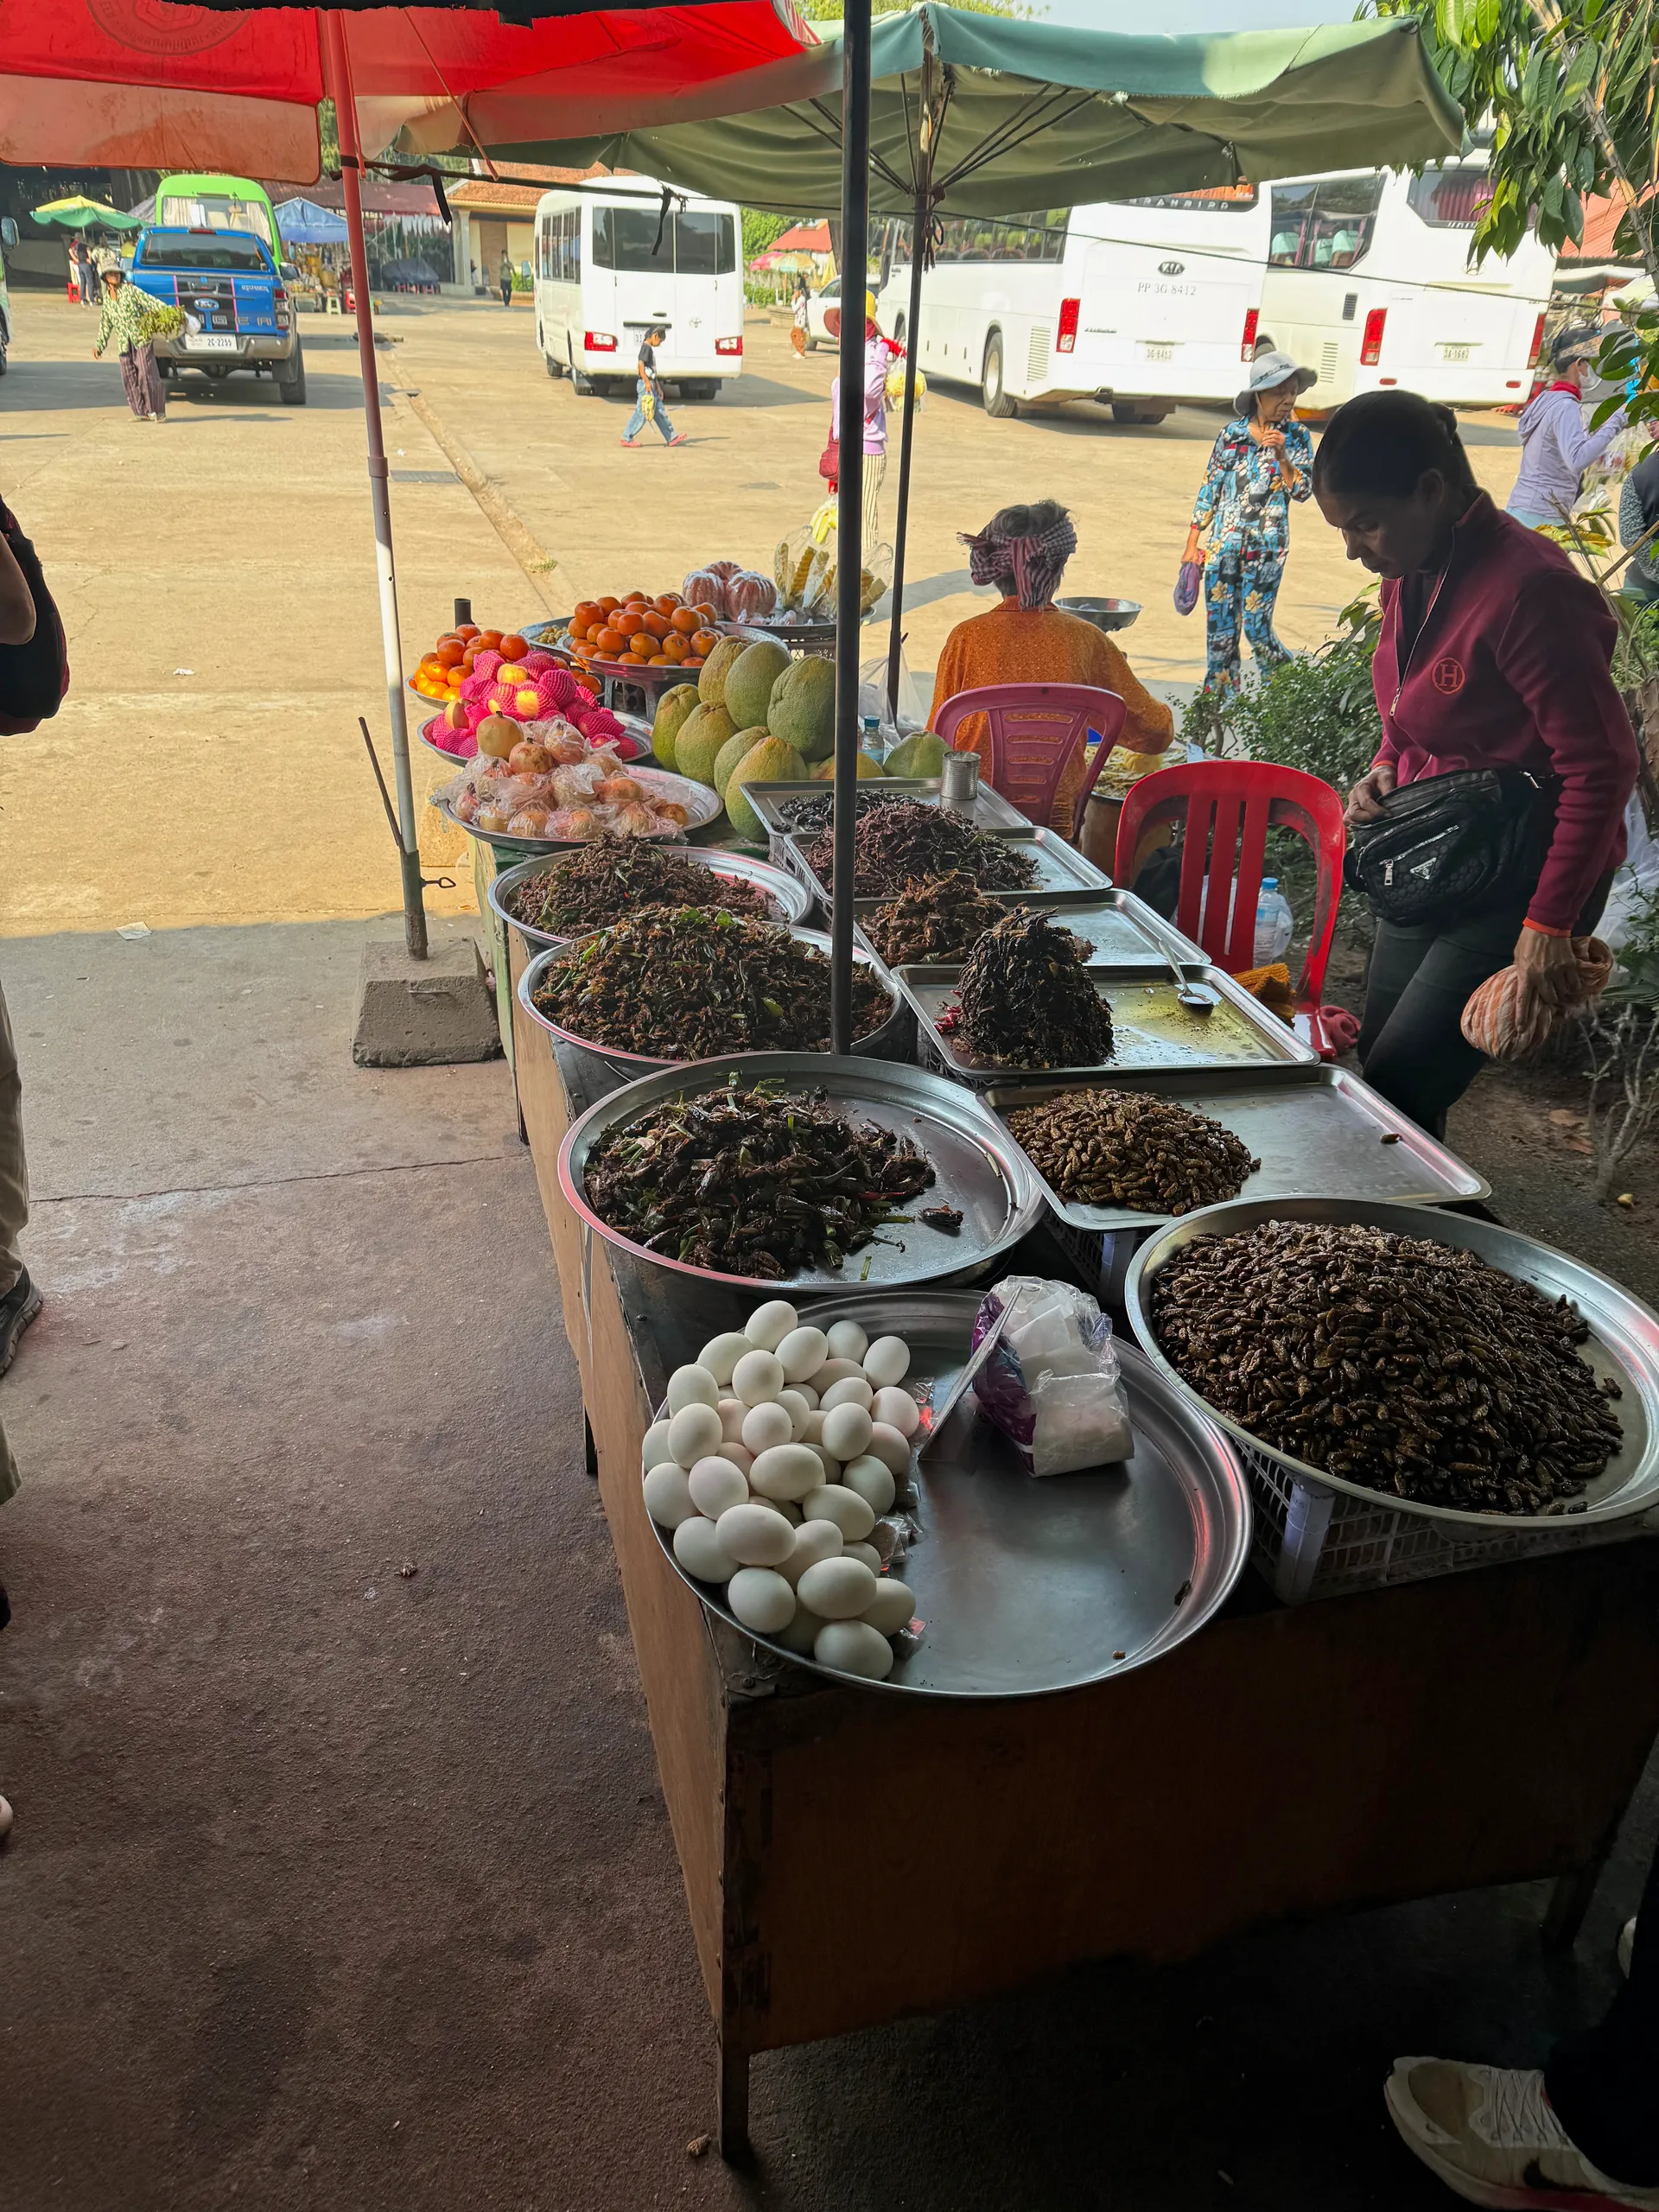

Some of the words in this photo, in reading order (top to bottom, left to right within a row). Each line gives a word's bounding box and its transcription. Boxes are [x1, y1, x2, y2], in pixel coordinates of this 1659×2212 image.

[1137, 283, 1151, 293] PP
[1171, 285, 1197, 296] 8412
[1440, 664, 1459, 688] H
